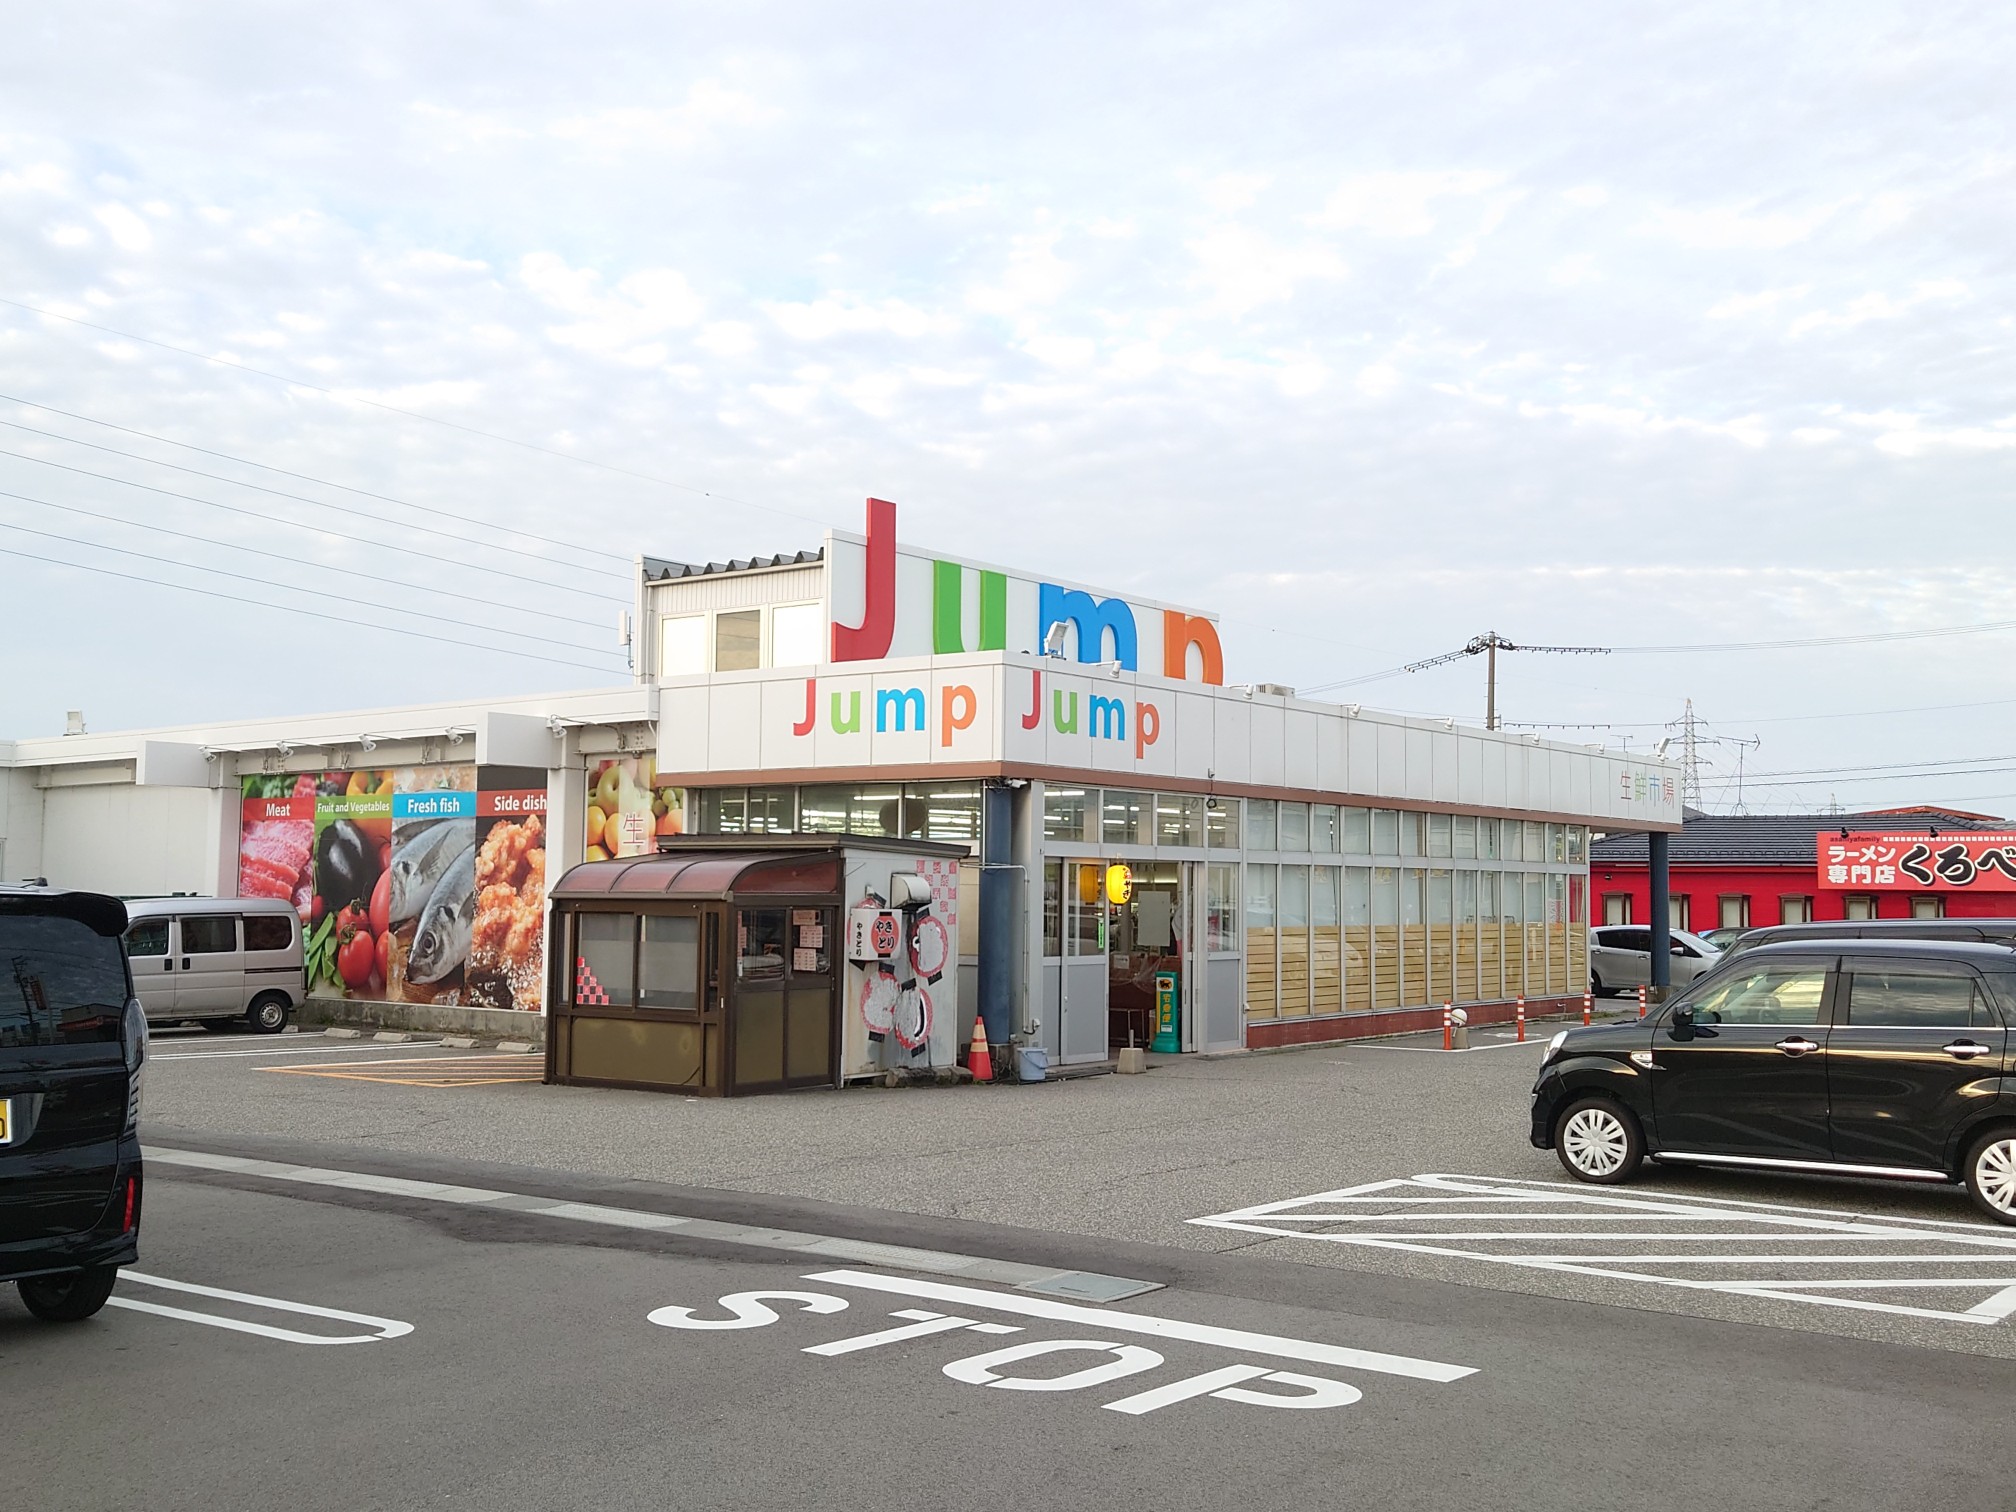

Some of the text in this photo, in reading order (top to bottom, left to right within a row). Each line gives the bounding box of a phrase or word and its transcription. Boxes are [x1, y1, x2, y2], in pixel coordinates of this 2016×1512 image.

[793, 679, 977, 748] Jump
[1021, 670, 1160, 760] Jump
[1620, 770, 1674, 809] 生鮮市場
[266, 803, 291, 817] Meat
[317, 802, 390, 814] Fruit and Vegetables
[407, 798, 460, 814] Fresh fish
[494, 794, 547, 811] Side dish
[623, 813, 643, 843] 生
[1828, 845, 1896, 863] ラーメン
[1898, 843, 2016, 886] くろべ
[1827, 865, 1896, 884] 専門店
[876, 921, 893, 934] やき
[878, 936, 895, 949] とり
[646, 1289, 1363, 1415] STOP
